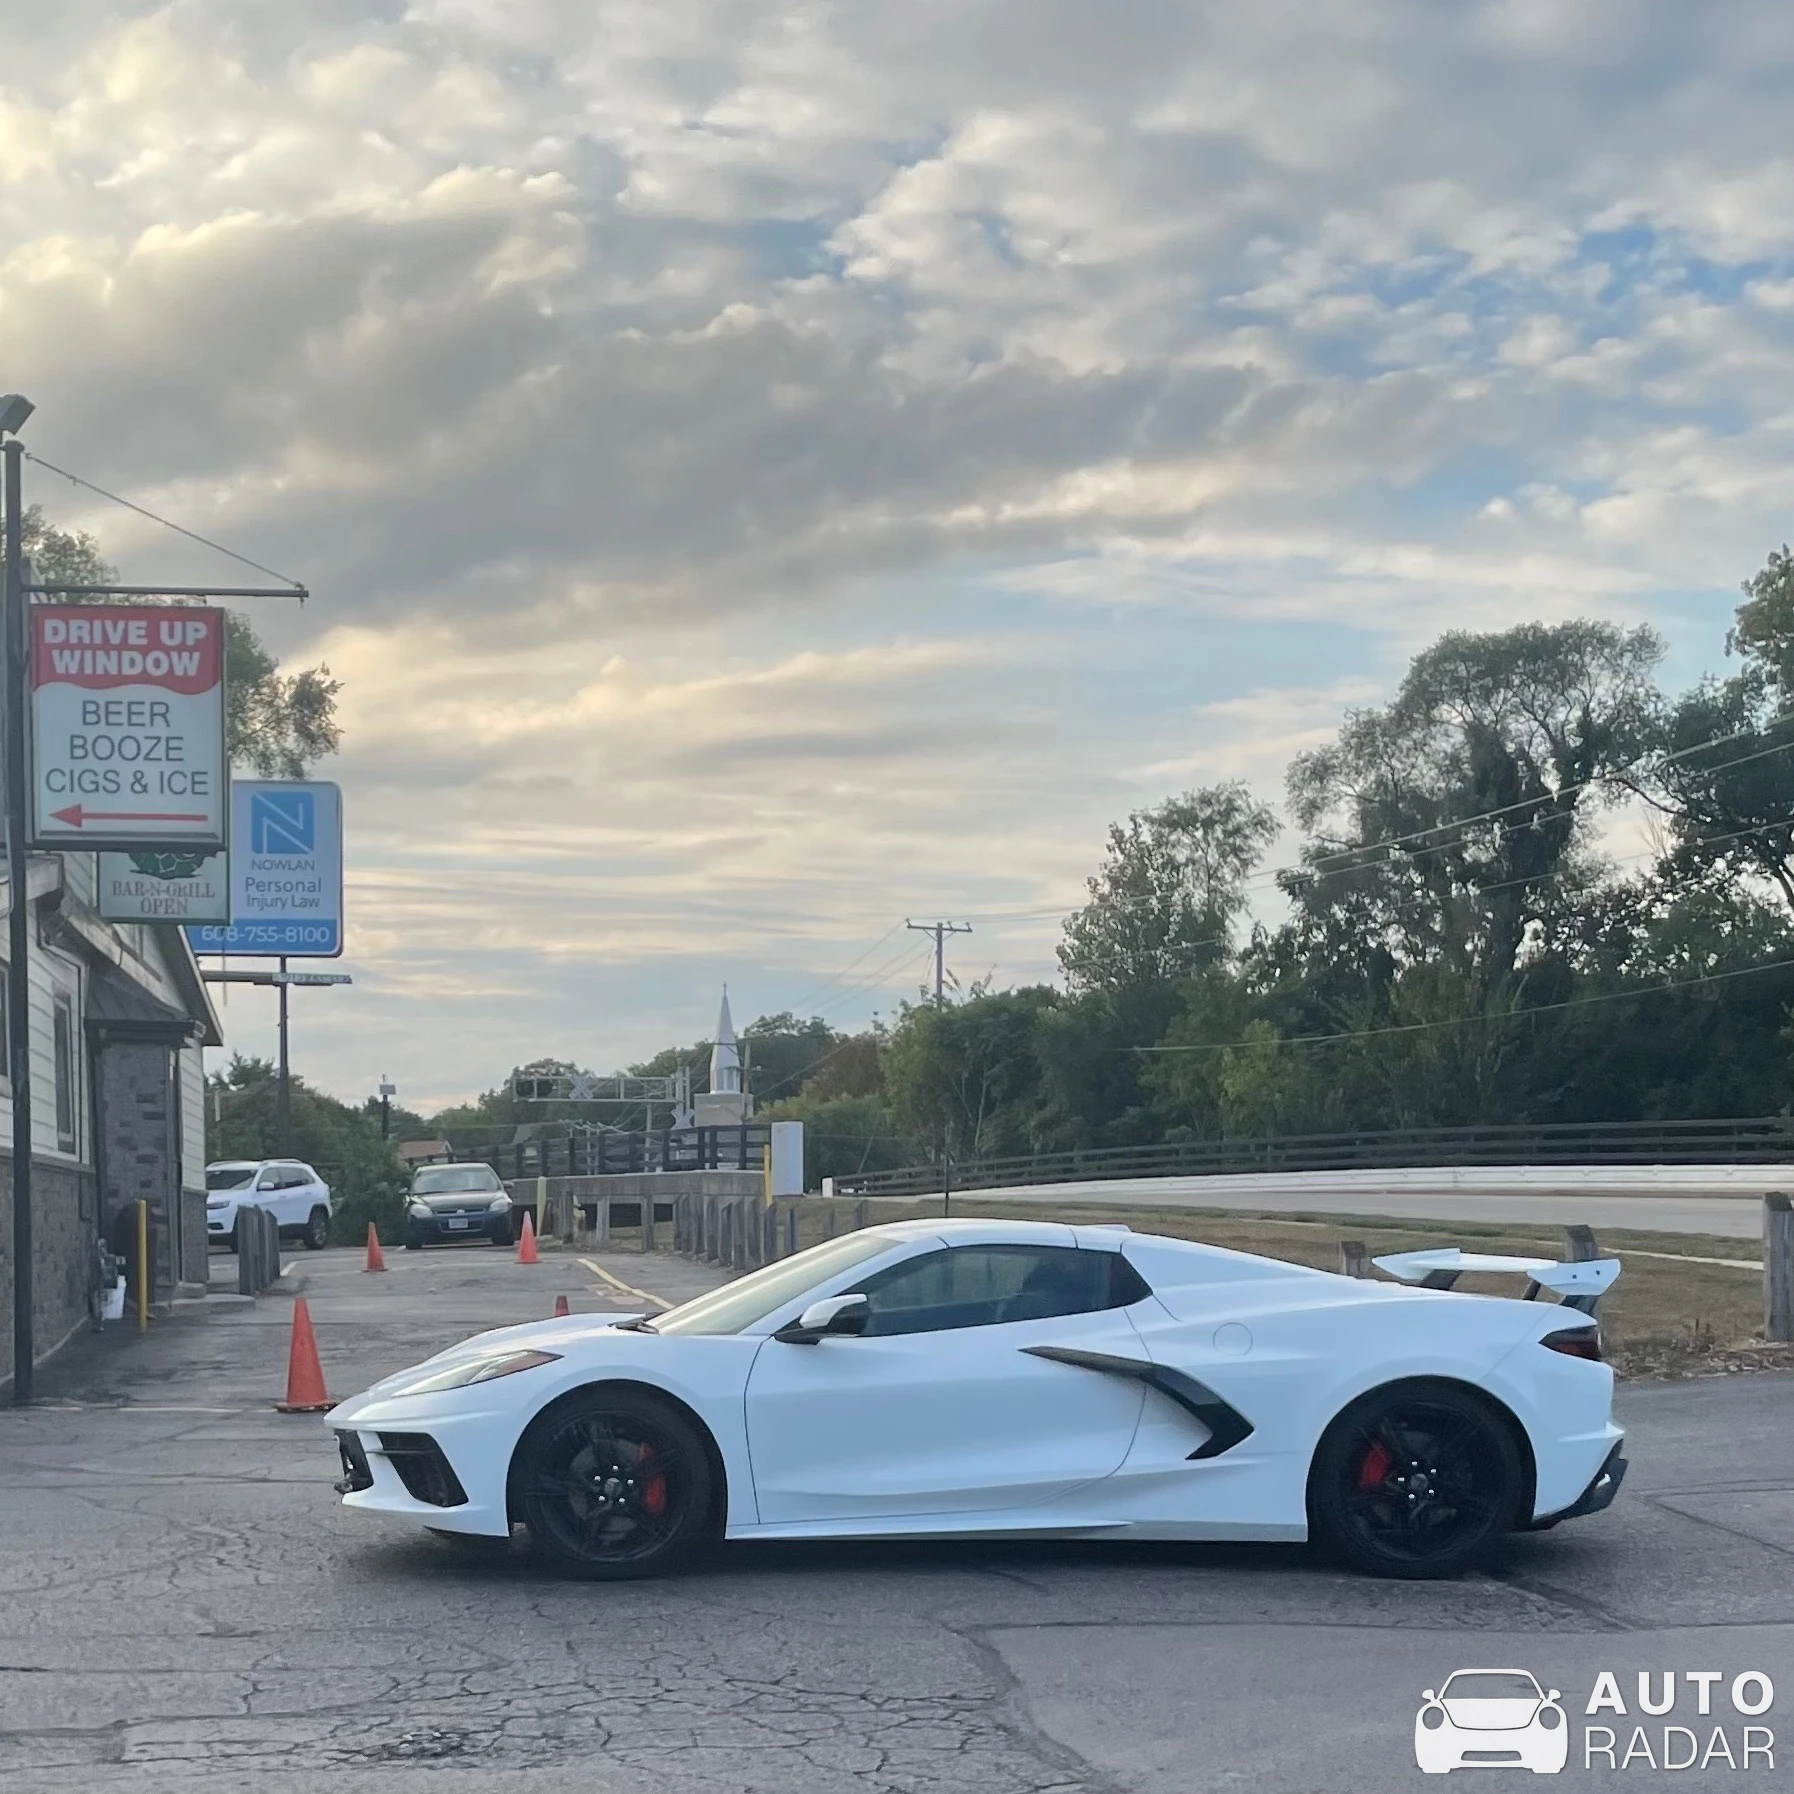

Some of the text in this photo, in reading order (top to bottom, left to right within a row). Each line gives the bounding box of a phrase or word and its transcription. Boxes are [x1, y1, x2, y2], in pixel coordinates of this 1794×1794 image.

[44, 619, 208, 646] DRIVE UP
[50, 649, 200, 677] WINDOW
[82, 701, 171, 728] BEER
[69, 734, 185, 762] BOOZE
[45, 768, 209, 796] CIGS & ICE
[251, 859, 316, 871] NOWLAN
[112, 881, 216, 898] BAR-N-GRILL
[245, 876, 322, 893] Personal
[140, 898, 189, 915] OPEN
[246, 894, 321, 911] Injury Law
[201, 925, 330, 943] 608-755-8100
